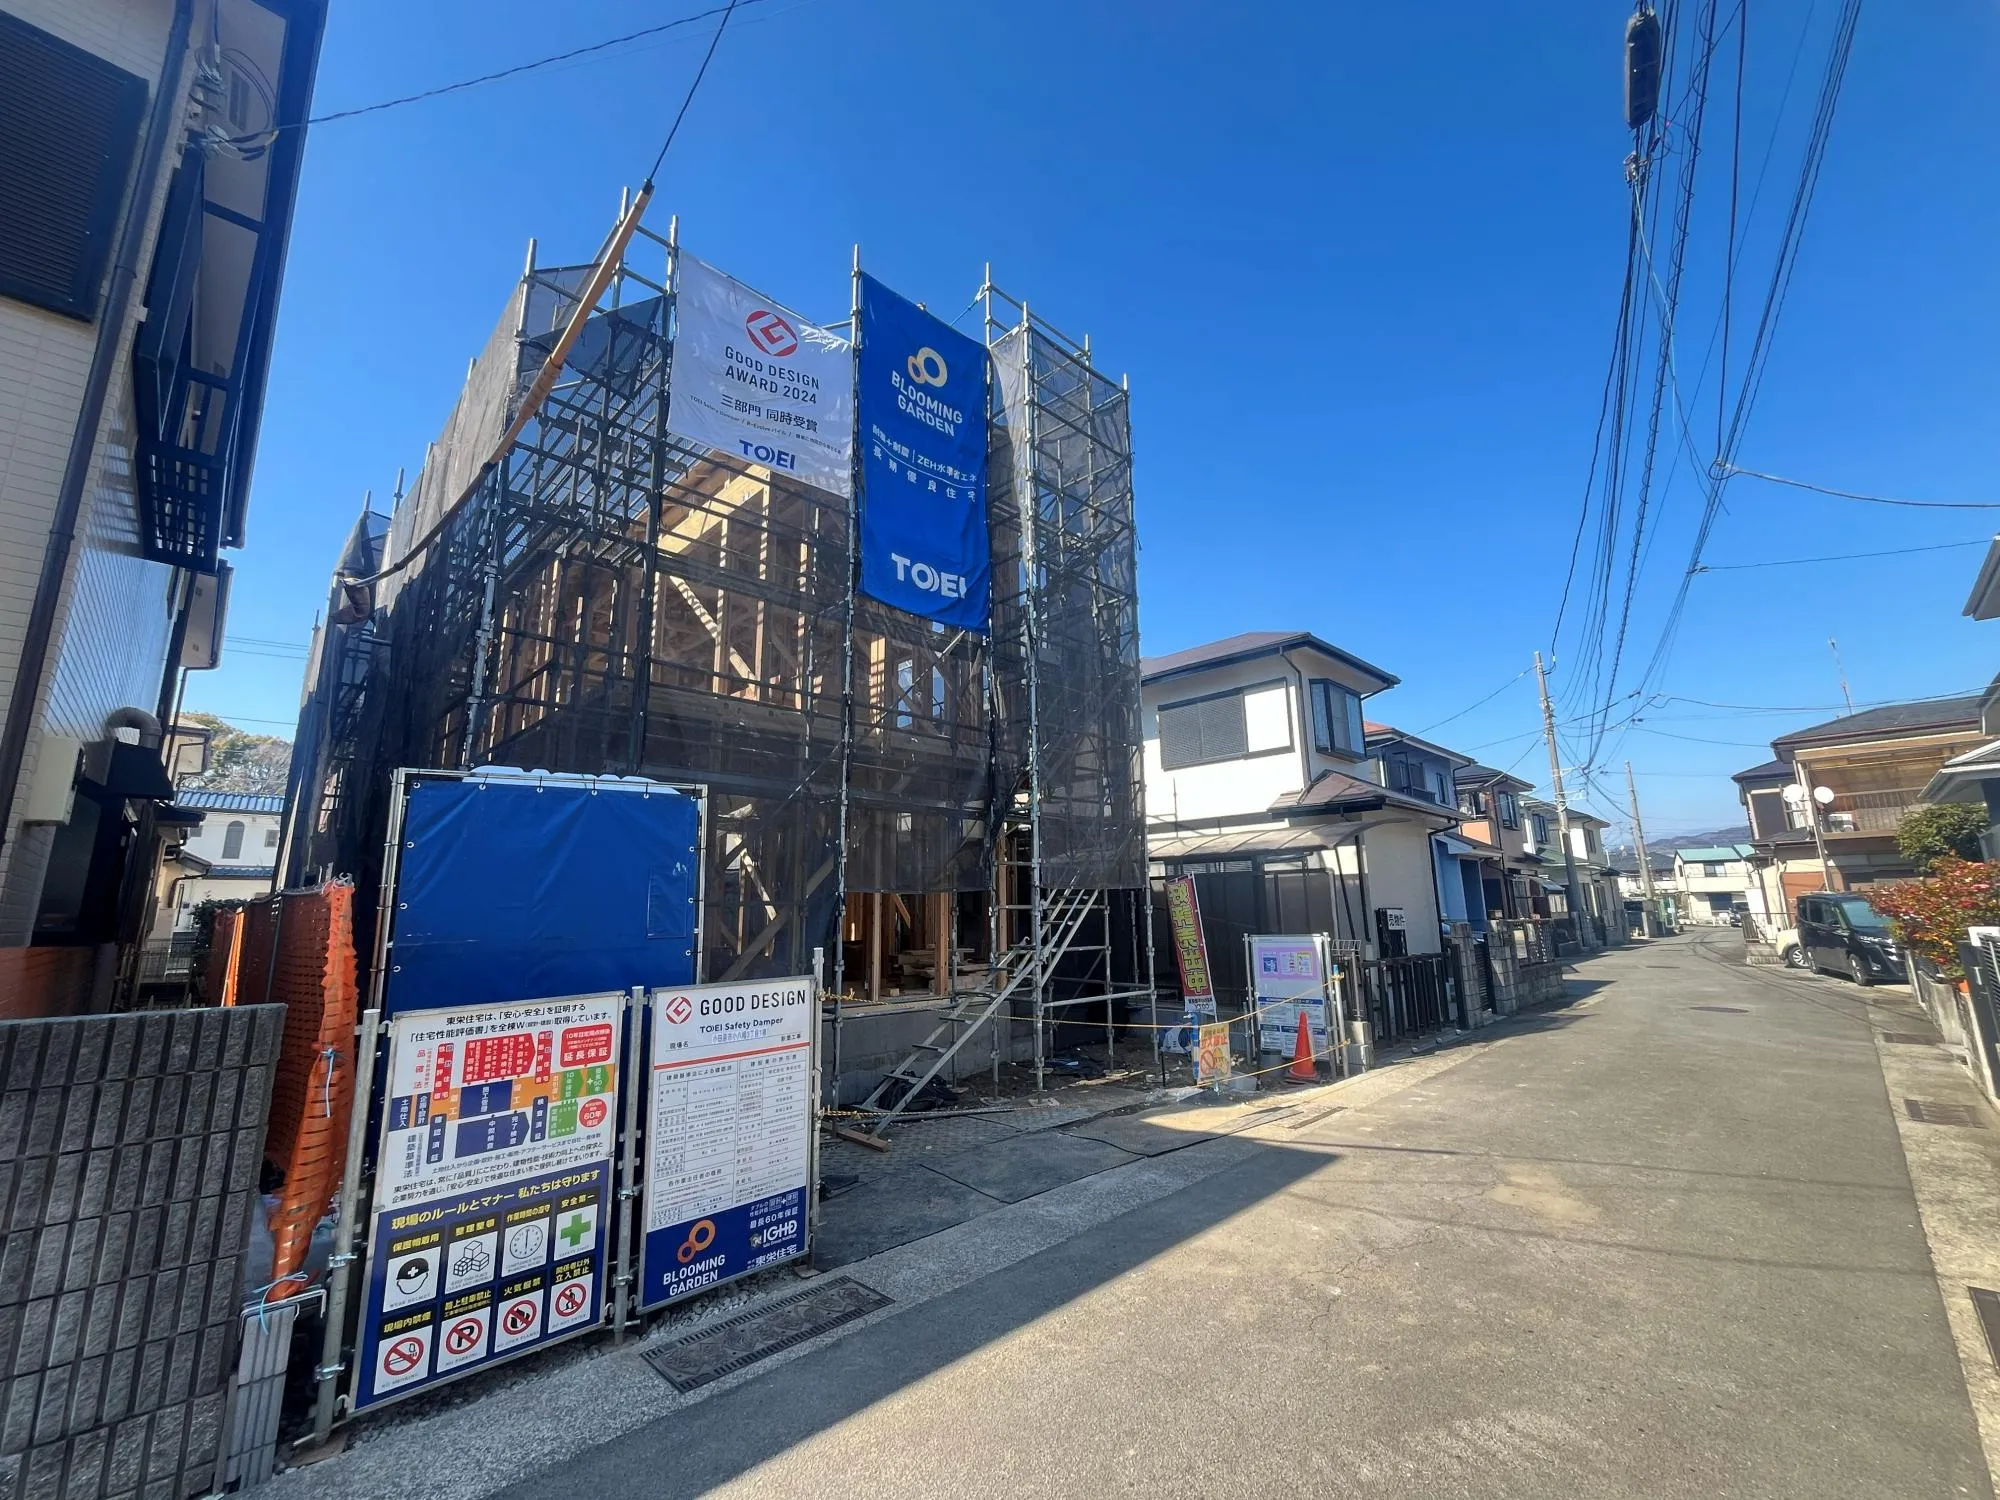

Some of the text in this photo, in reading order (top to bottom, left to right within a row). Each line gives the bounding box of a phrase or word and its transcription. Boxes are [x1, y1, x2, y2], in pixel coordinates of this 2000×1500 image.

[725, 346, 819, 390] GOOD DESIGN
[726, 366, 816, 404] AWARD 2024
[892, 371, 962, 424] BLOOMING
[721, 394, 818, 433] 三部門 同時受賞
[898, 394, 955, 437] GARDEN
[739, 439, 795, 470] TOEI
[892, 552, 967, 599] TOEI
[700, 989, 806, 1016] GOOD DESIGN
[699, 1015, 782, 1034] TOEI Safety Damper
[391, 1168, 600, 1230] 現場のルールとマナー 私たちは守ります
[560, 1192, 595, 1208] 安全第一
[663, 1253, 725, 1285] BLOOMING
[755, 1243, 796, 1267] 東栄住宅
[555, 1265, 589, 1282] 立入禁止
[669, 1269, 718, 1296] GARDEN
